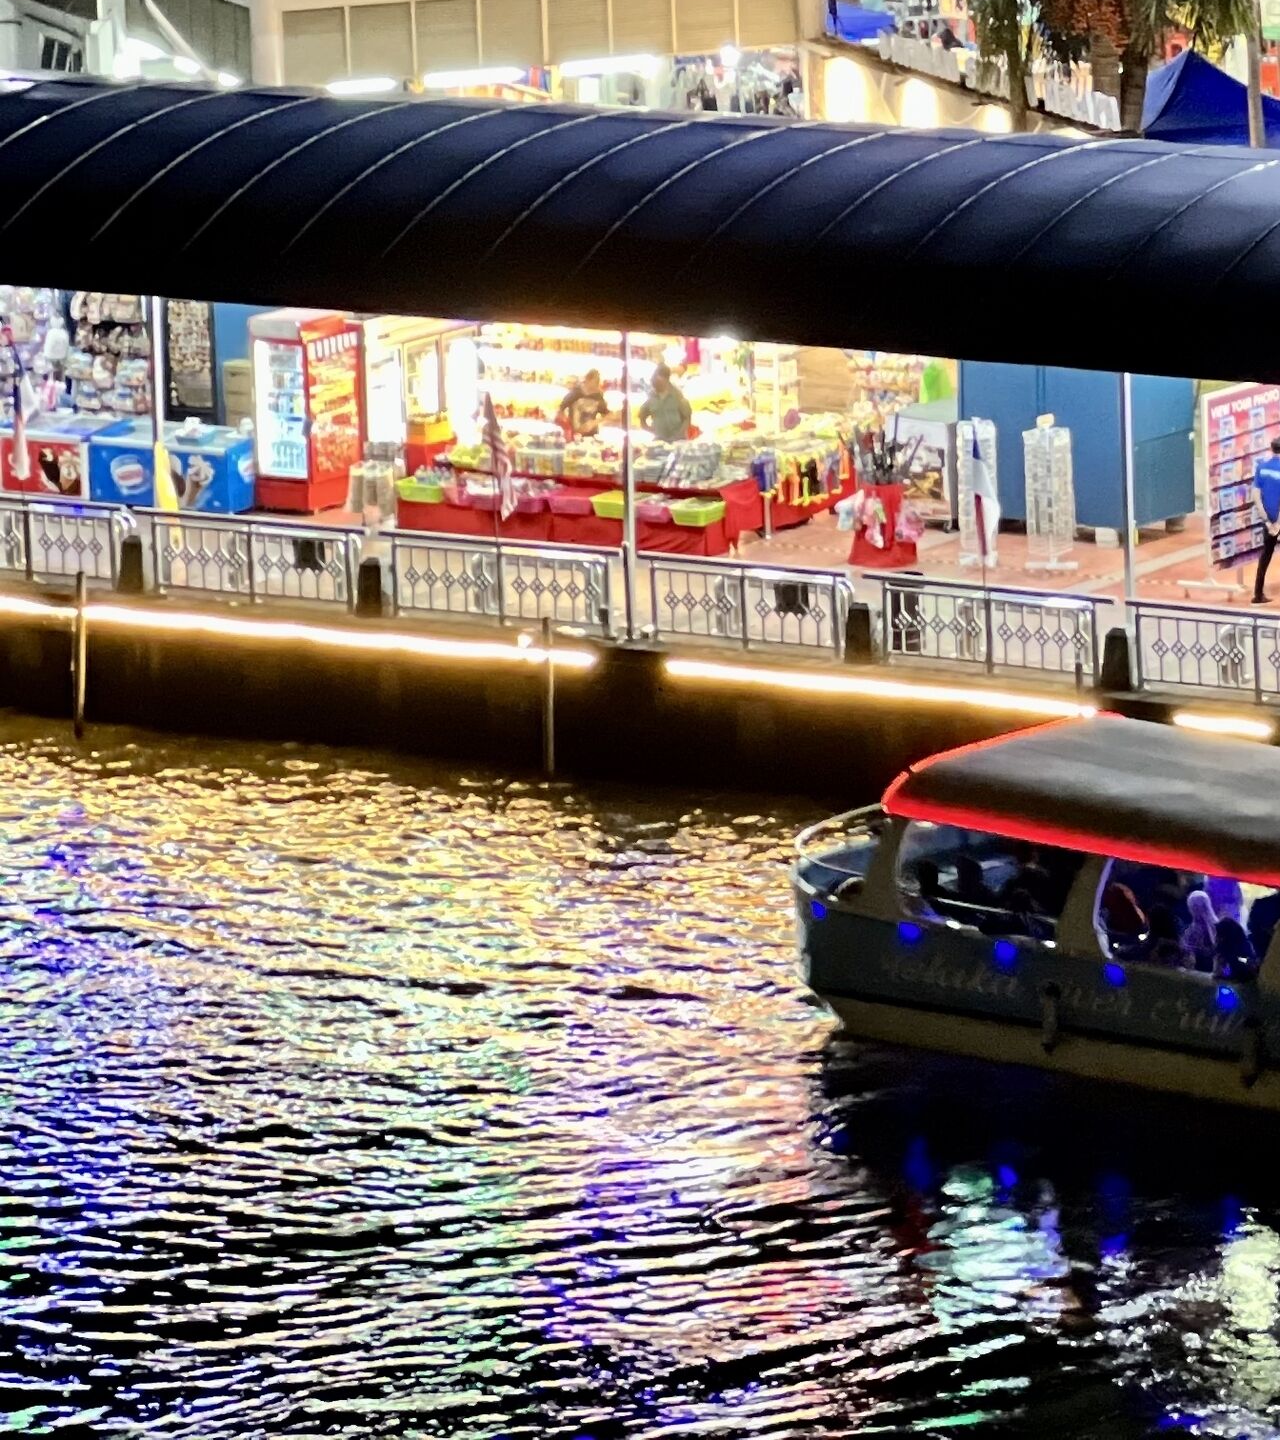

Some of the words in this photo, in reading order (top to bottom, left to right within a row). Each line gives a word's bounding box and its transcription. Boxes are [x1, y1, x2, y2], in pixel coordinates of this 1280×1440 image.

[1210, 401, 1231, 417] VIEW
[1231, 394, 1253, 413] YOUR
[1253, 388, 1279, 406] PHOTO
